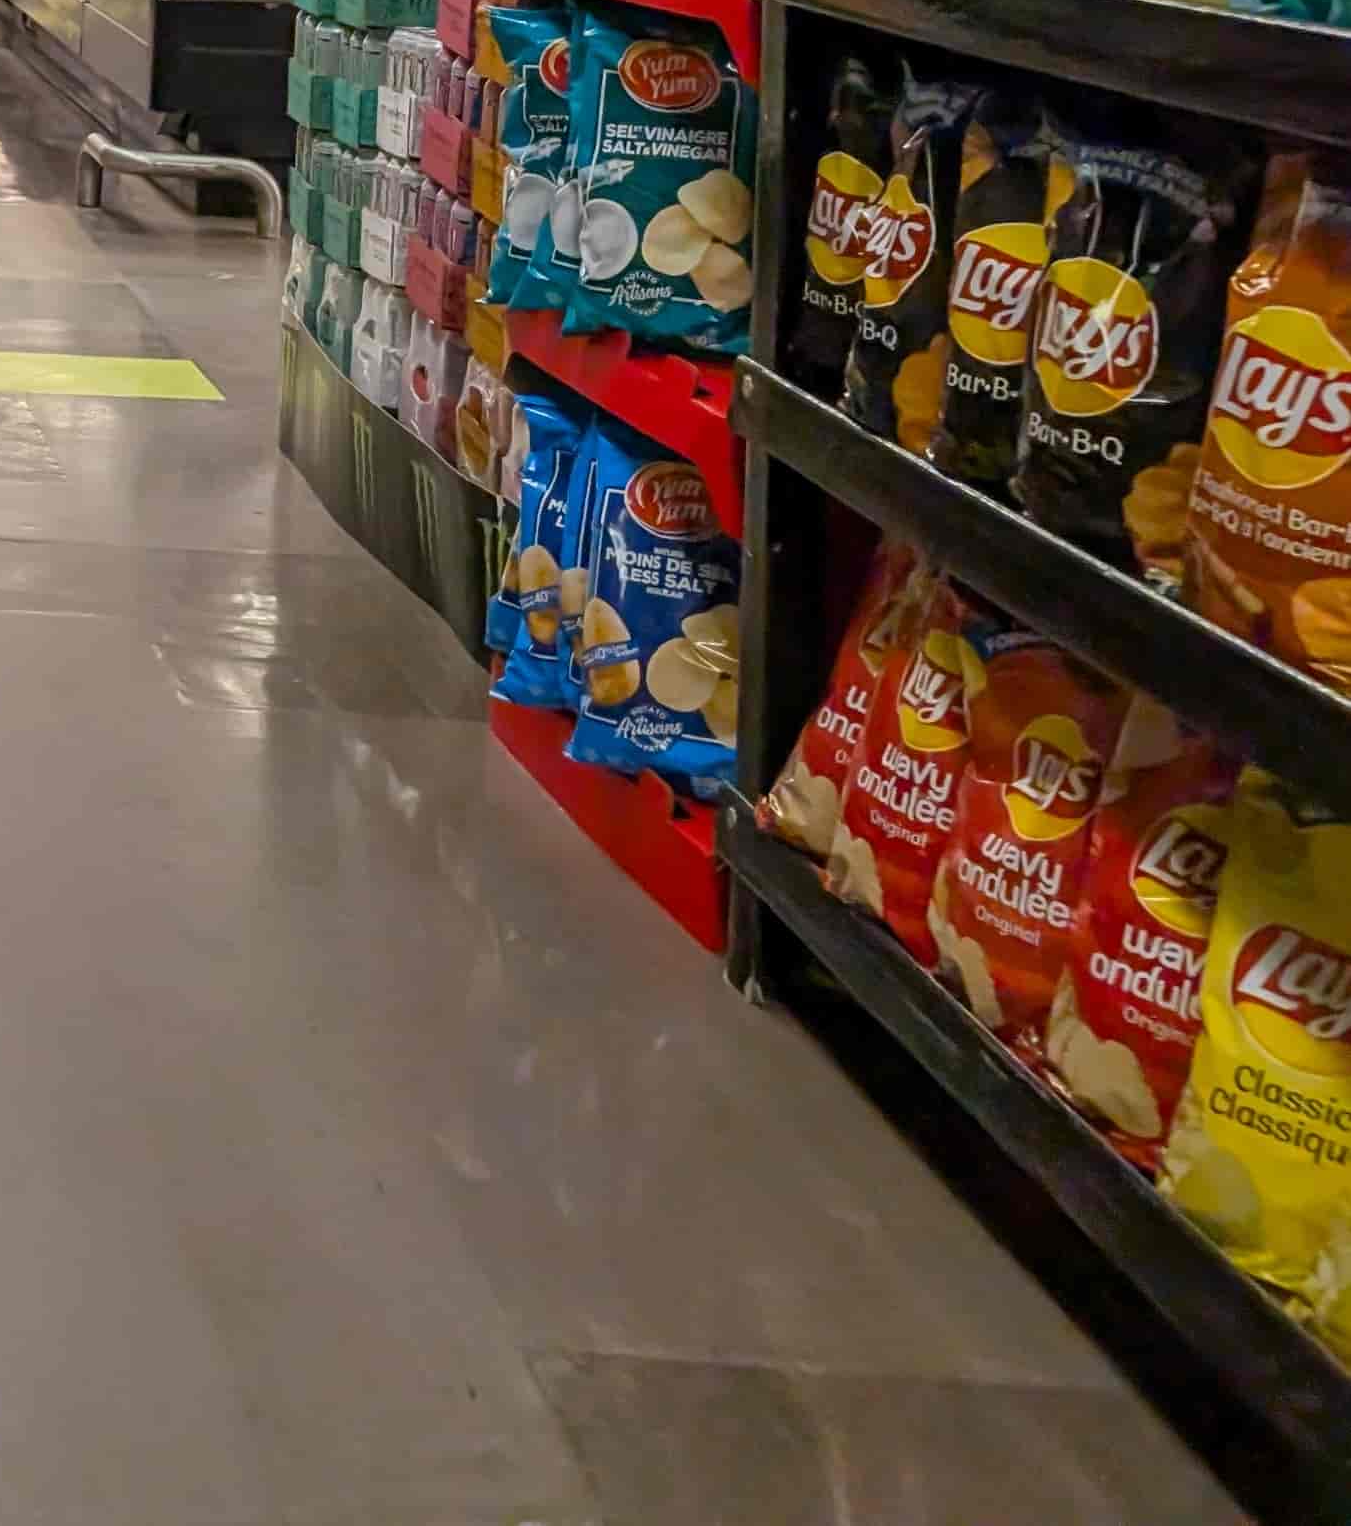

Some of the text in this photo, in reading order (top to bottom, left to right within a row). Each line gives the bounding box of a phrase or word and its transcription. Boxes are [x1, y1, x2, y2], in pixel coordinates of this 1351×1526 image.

[640, 53, 689, 76] Yum
[650, 76, 698, 99] Yum
[602, 139, 643, 156] SALT
[650, 142, 730, 163] VINEGAR
[606, 123, 730, 146] SEL VINAIGRE
[608, 283, 674, 308] Artisans
[950, 242, 1041, 331] Lay
[1215, 335, 1351, 449] Lay's
[656, 503, 708, 527] Yum
[606, 545, 662, 570] MOINS
[665, 557, 692, 575] DE
[620, 564, 660, 587] LESS
[664, 573, 717, 595] SALT
[882, 742, 952, 802] wavy
[857, 765, 956, 832] ondulée
[869, 808, 928, 848] Original
[981, 833, 1063, 897] wavy
[959, 854, 1072, 928] ondulée
[975, 905, 1042, 947] Original
[1123, 922, 1204, 976] wav
[1238, 929, 1351, 1042] Lay
[1209, 1087, 1351, 1167] Classiqu
